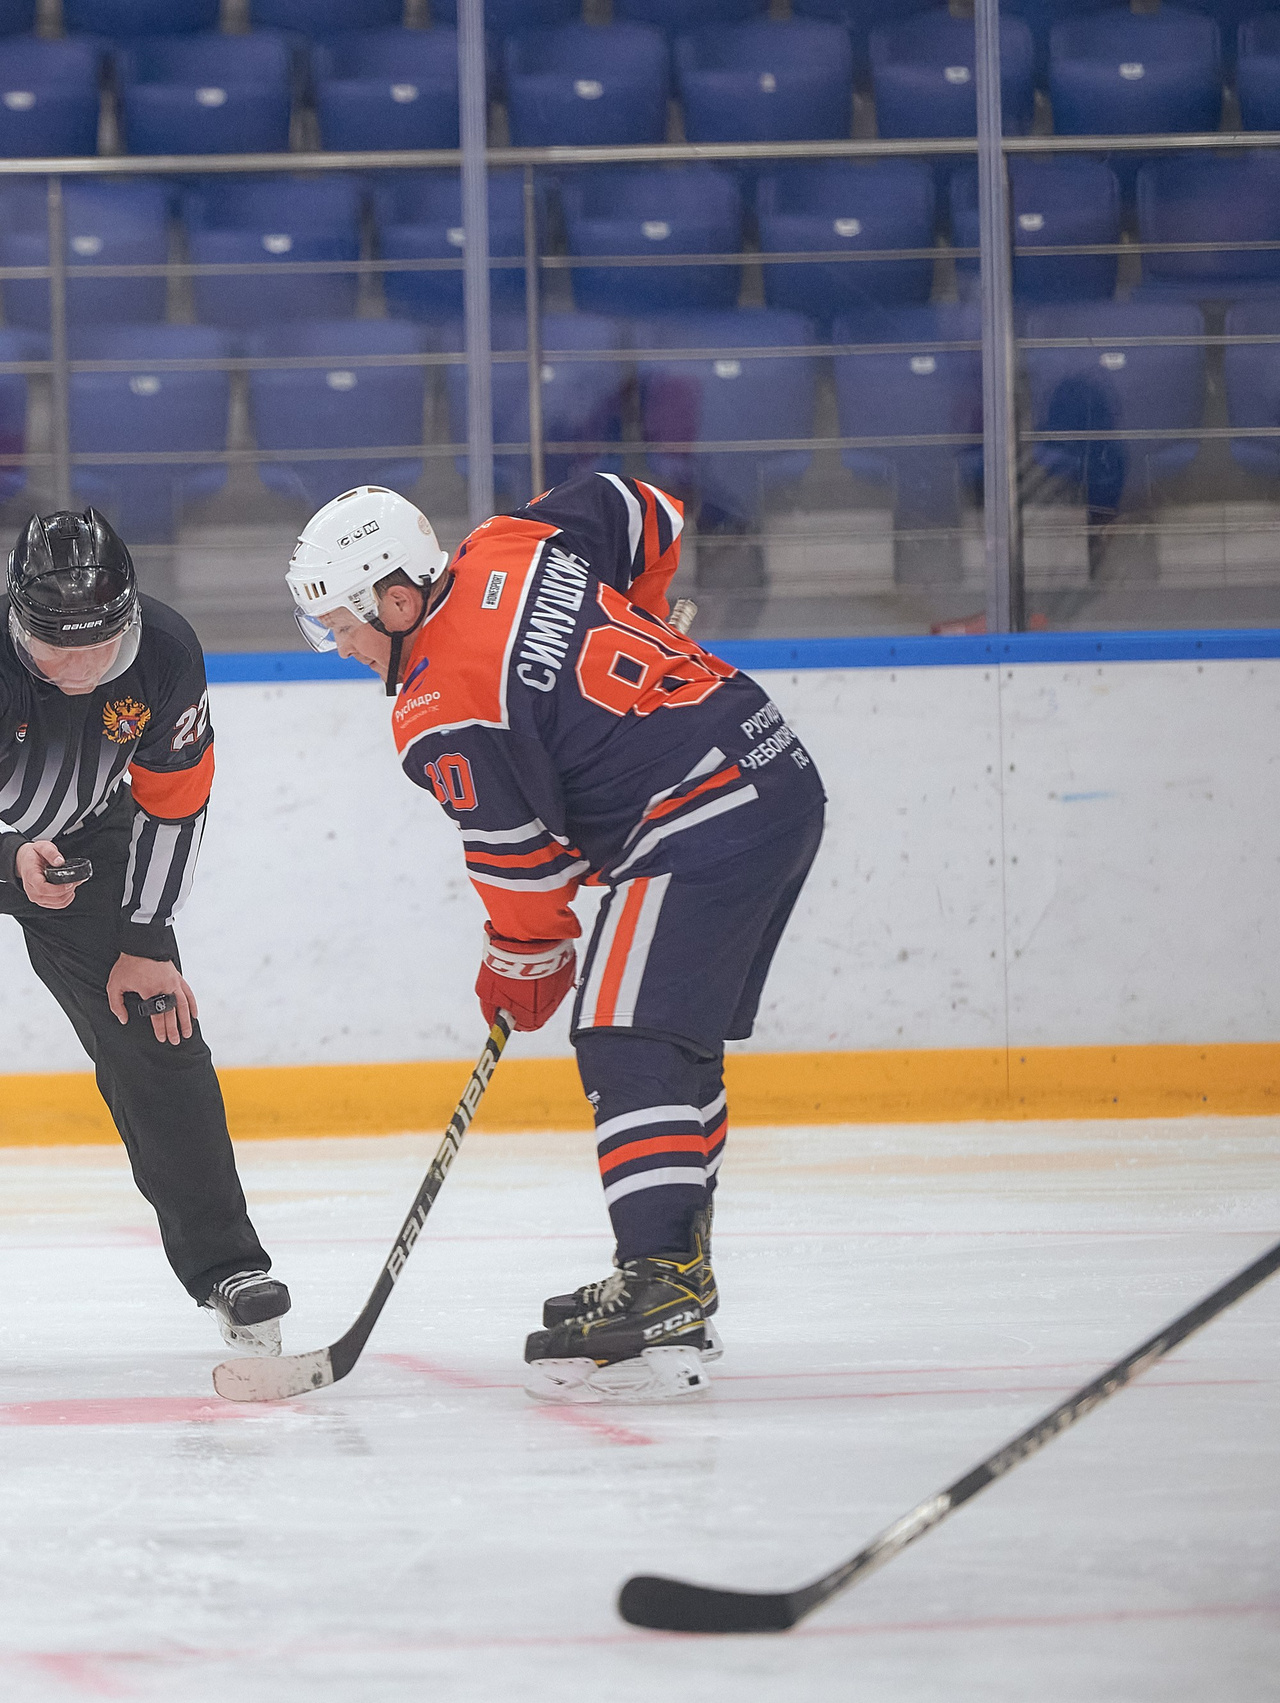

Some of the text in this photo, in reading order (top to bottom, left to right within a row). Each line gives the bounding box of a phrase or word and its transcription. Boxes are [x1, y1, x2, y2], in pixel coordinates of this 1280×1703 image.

[338, 520, 380, 549] CCM
[62, 620, 103, 631] BAUER
[171, 687, 208, 752] 22
[642, 1308, 704, 1341] CCM
